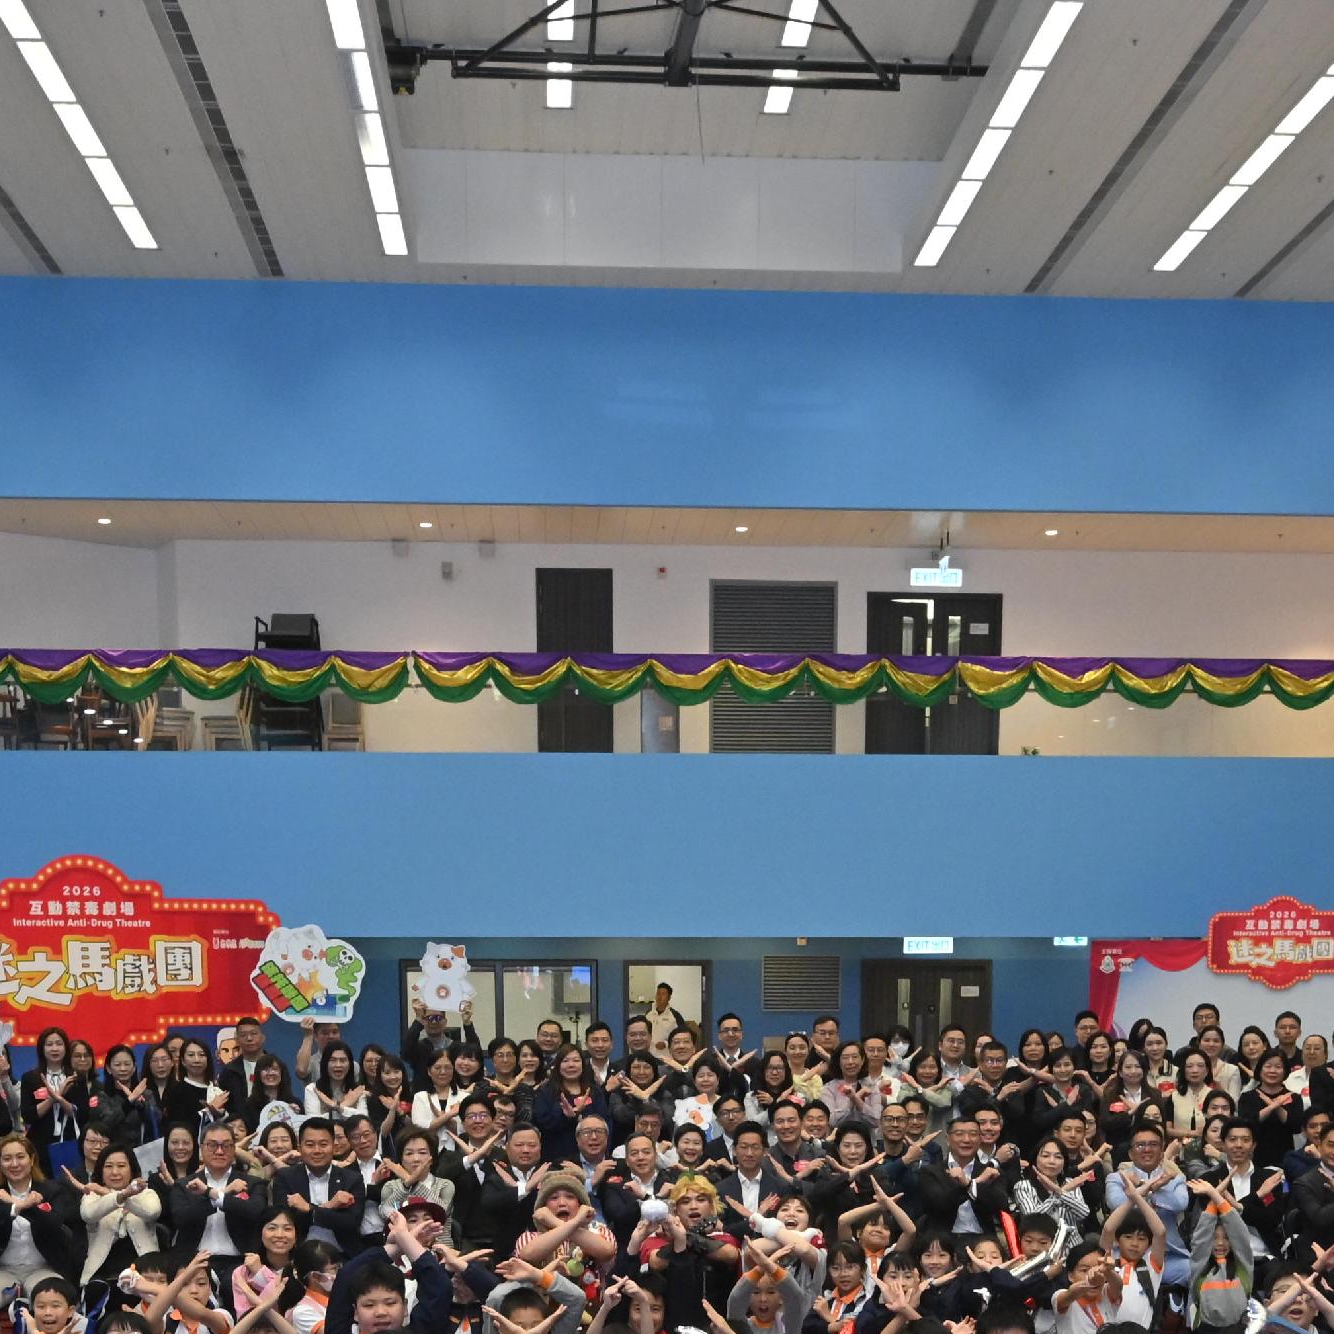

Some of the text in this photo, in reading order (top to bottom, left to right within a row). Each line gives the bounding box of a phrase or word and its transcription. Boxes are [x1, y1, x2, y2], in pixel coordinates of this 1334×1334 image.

[63, 885, 101, 897] 2026
[29, 900, 135, 916] 互動禁毒劇場
[13, 918, 151, 929] Interactive Anti-Drug Theatre
[907, 941, 929, 951] EXIT
[1228, 938, 1334, 967] 迷之馬戲團
